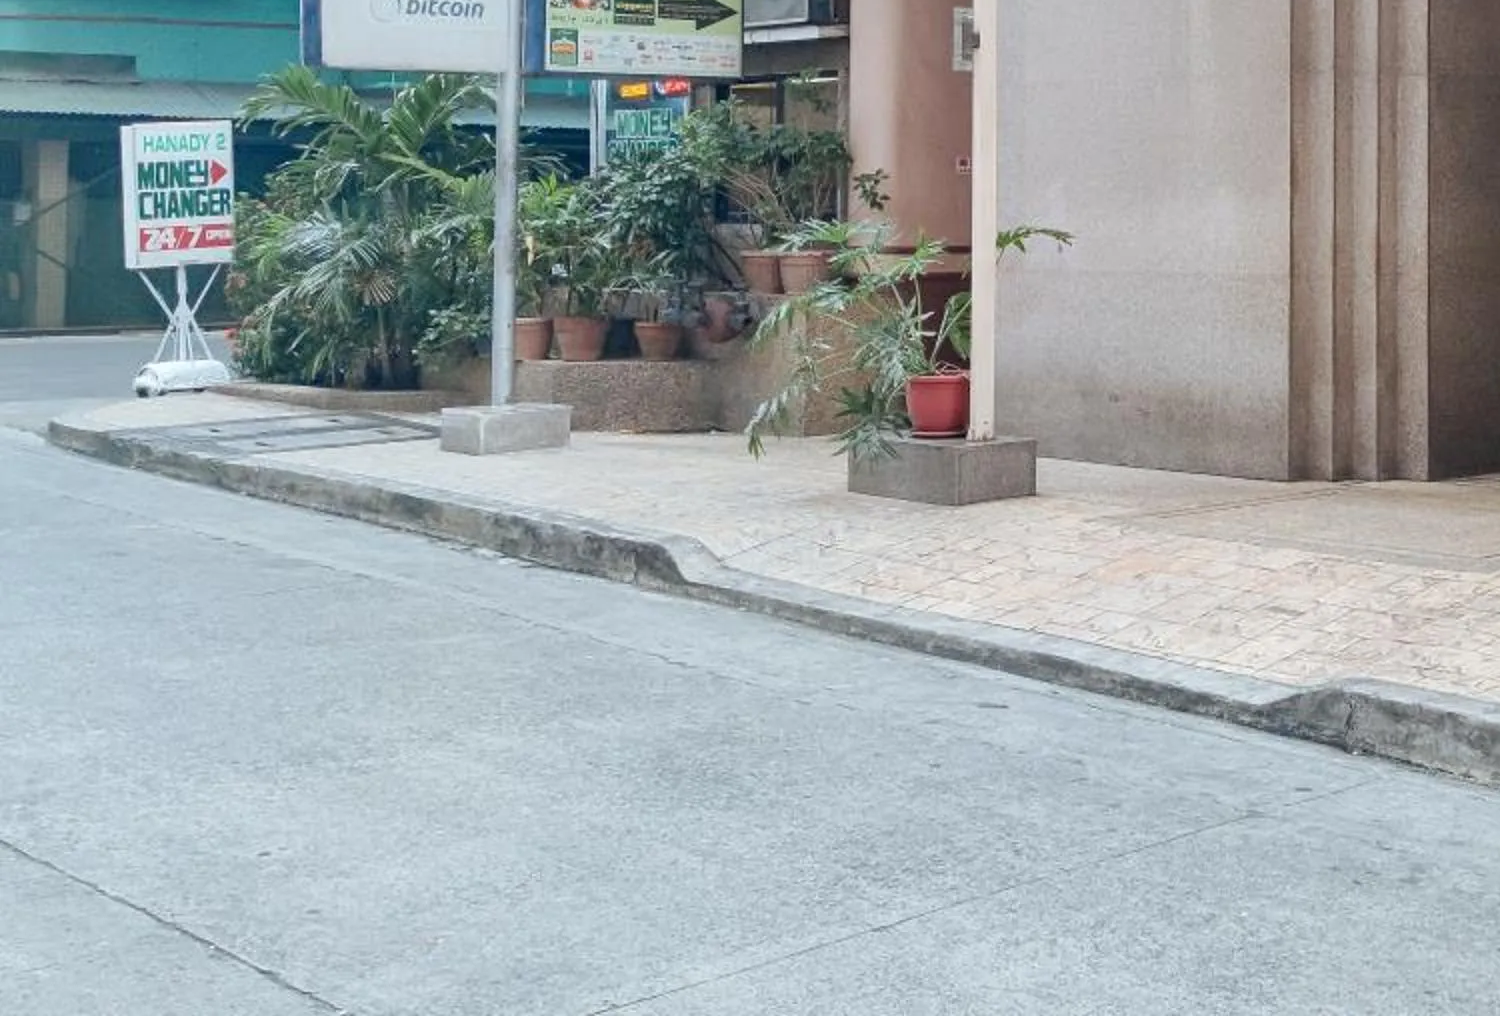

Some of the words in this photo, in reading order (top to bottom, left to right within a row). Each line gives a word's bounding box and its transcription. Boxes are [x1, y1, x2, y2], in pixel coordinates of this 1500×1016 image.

[143, 133, 210, 153] HANADY
[216, 132, 228, 151] 2
[137, 160, 209, 190] MONEY
[139, 188, 231, 220] CHANGER
[143, 225, 203, 251] 24/7
